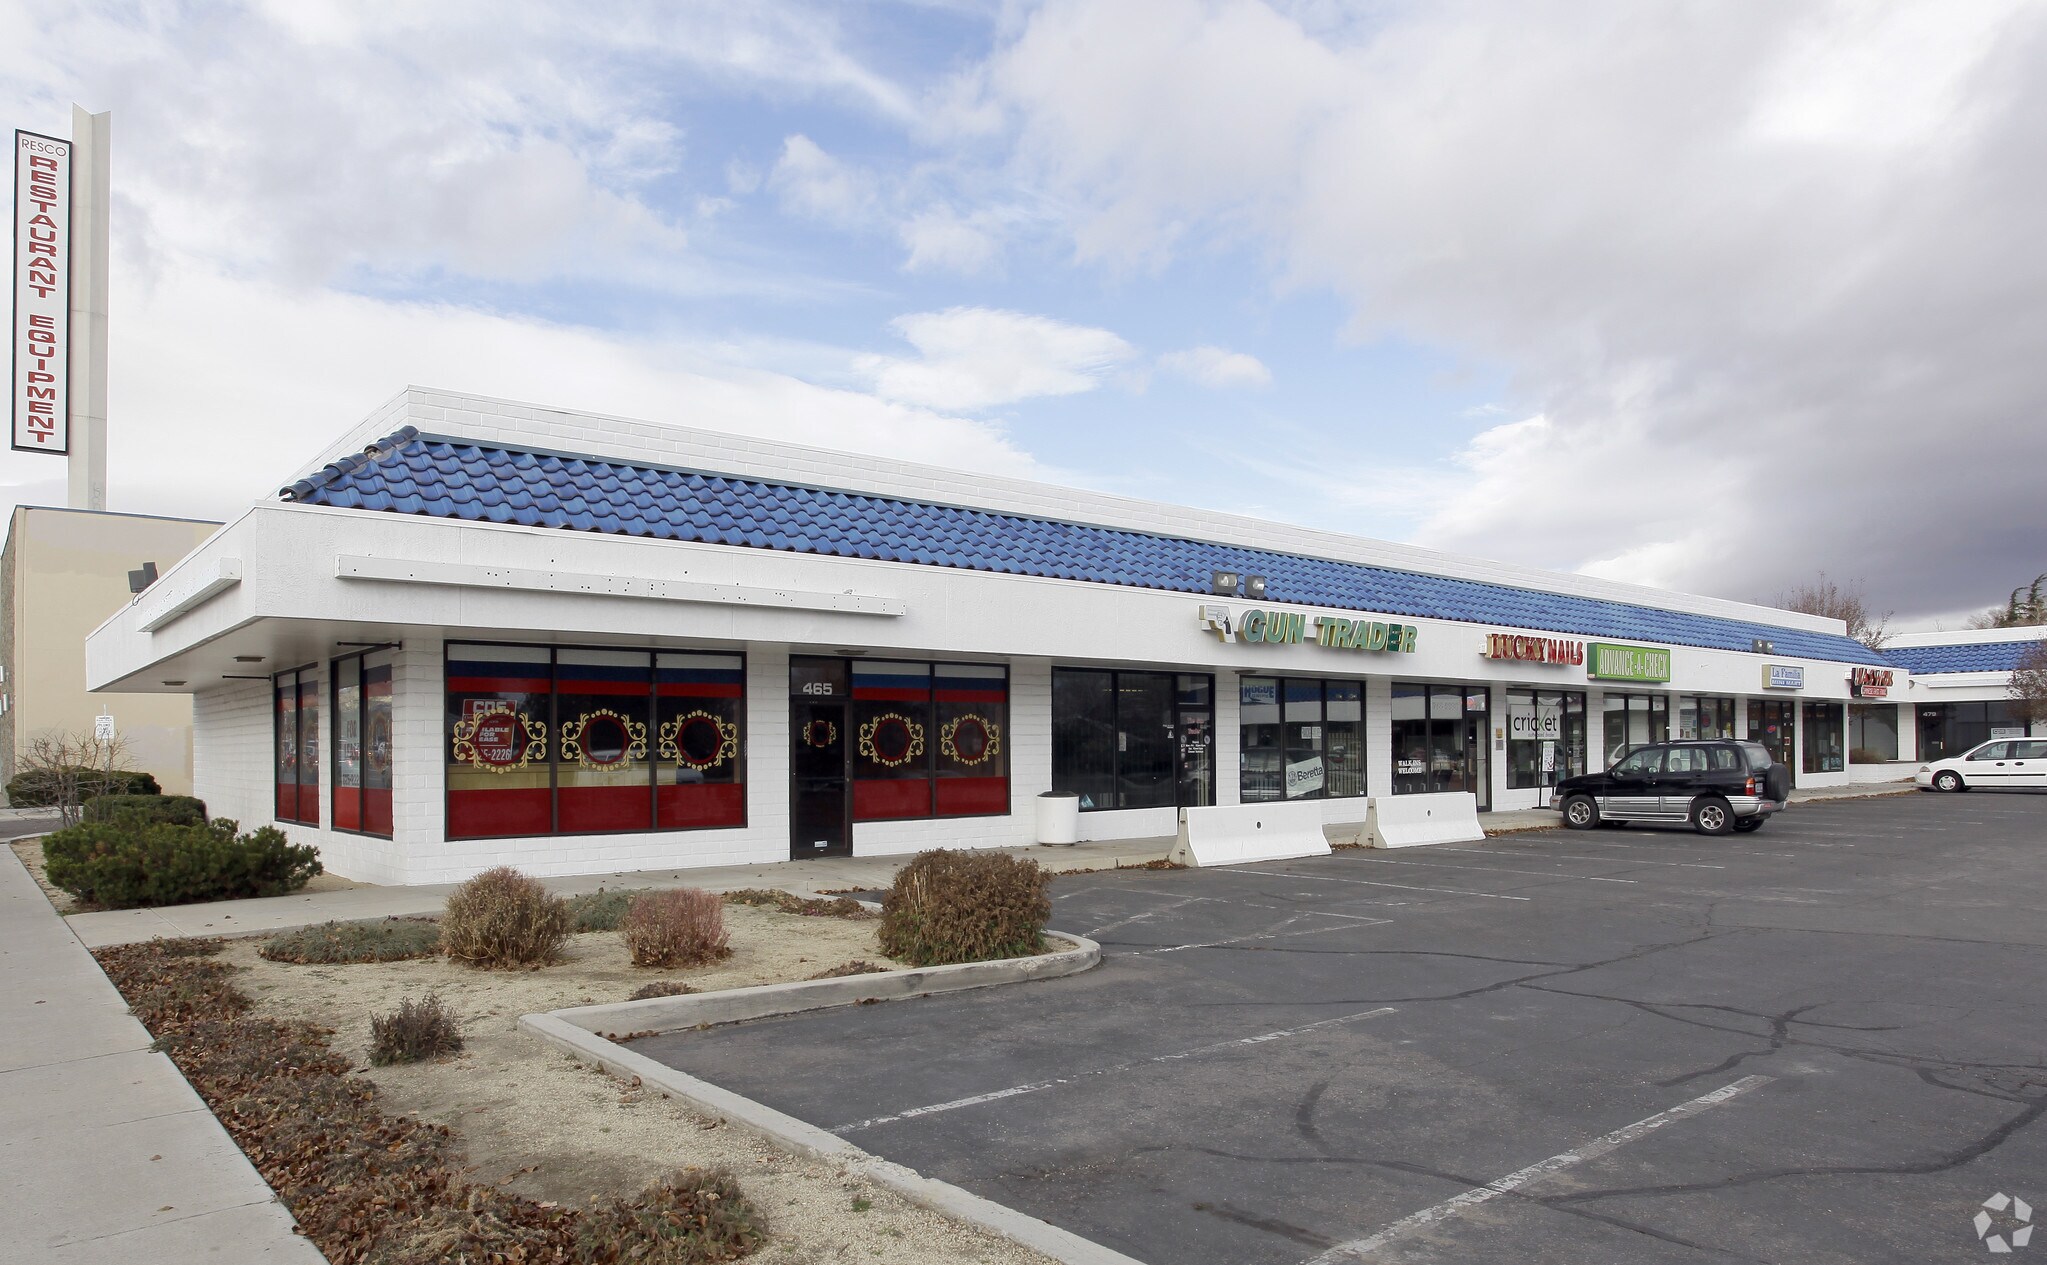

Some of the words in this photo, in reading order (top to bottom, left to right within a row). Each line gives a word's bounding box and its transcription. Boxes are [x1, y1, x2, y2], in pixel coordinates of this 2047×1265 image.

[21, 137, 67, 158] RESCO
[28, 154, 58, 298] RESTAURANT
[27, 314, 57, 444] EQUIPMENT
[1239, 609, 1307, 645] GUN
[1314, 616, 1418, 653] TRADER
[1485, 633, 1547, 662] LUCKY
[1547, 638, 1584, 666] NAILS
[1772, 667, 1780, 678] La
[802, 682, 833, 696] 465
[1513, 708, 1558, 732] cricket
[1297, 766, 1324, 781] Beretta
[1397, 767, 1423, 775] WELCOME
